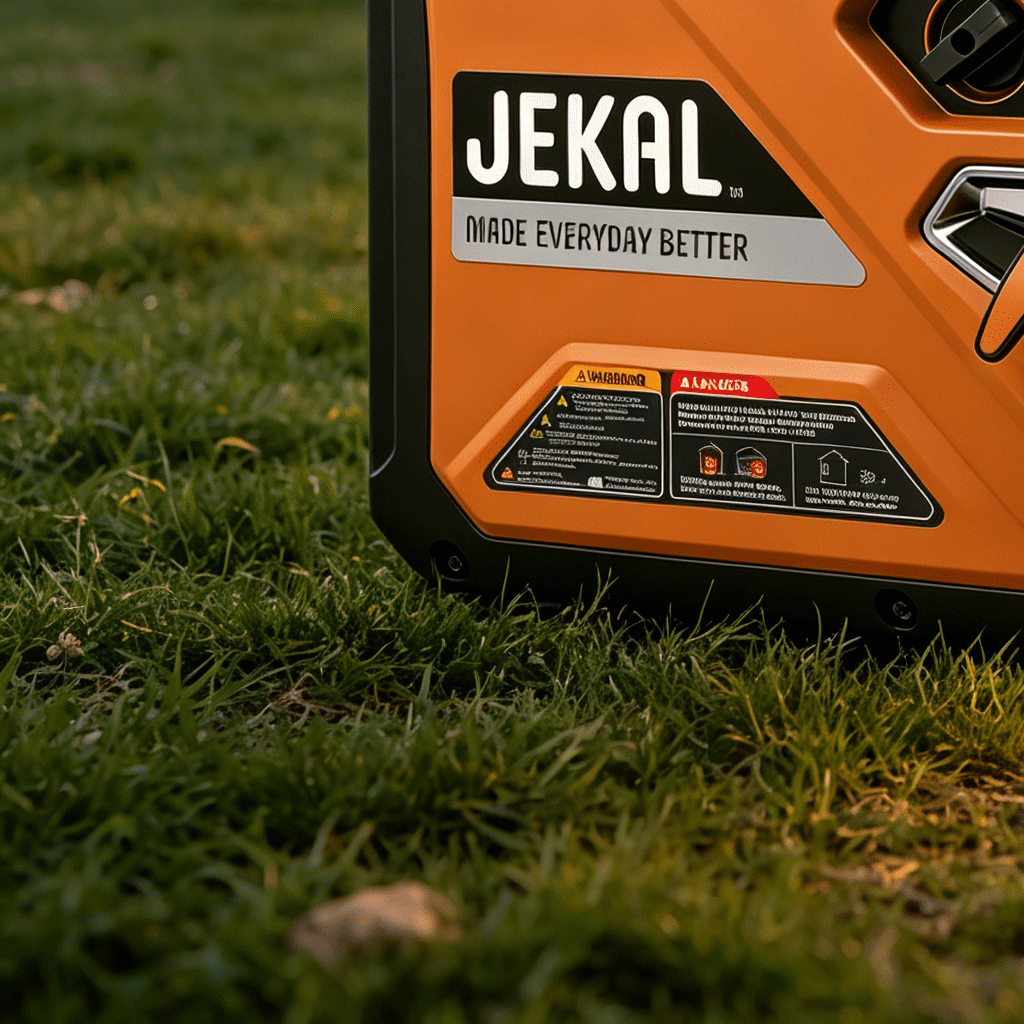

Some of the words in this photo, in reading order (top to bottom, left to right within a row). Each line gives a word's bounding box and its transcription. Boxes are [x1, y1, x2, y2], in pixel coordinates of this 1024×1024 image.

[466, 89, 723, 197] JEKAL
[466, 215, 527, 247] MADE
[536, 219, 653, 255] EVERYDAY
[659, 228, 749, 262] BETTER
